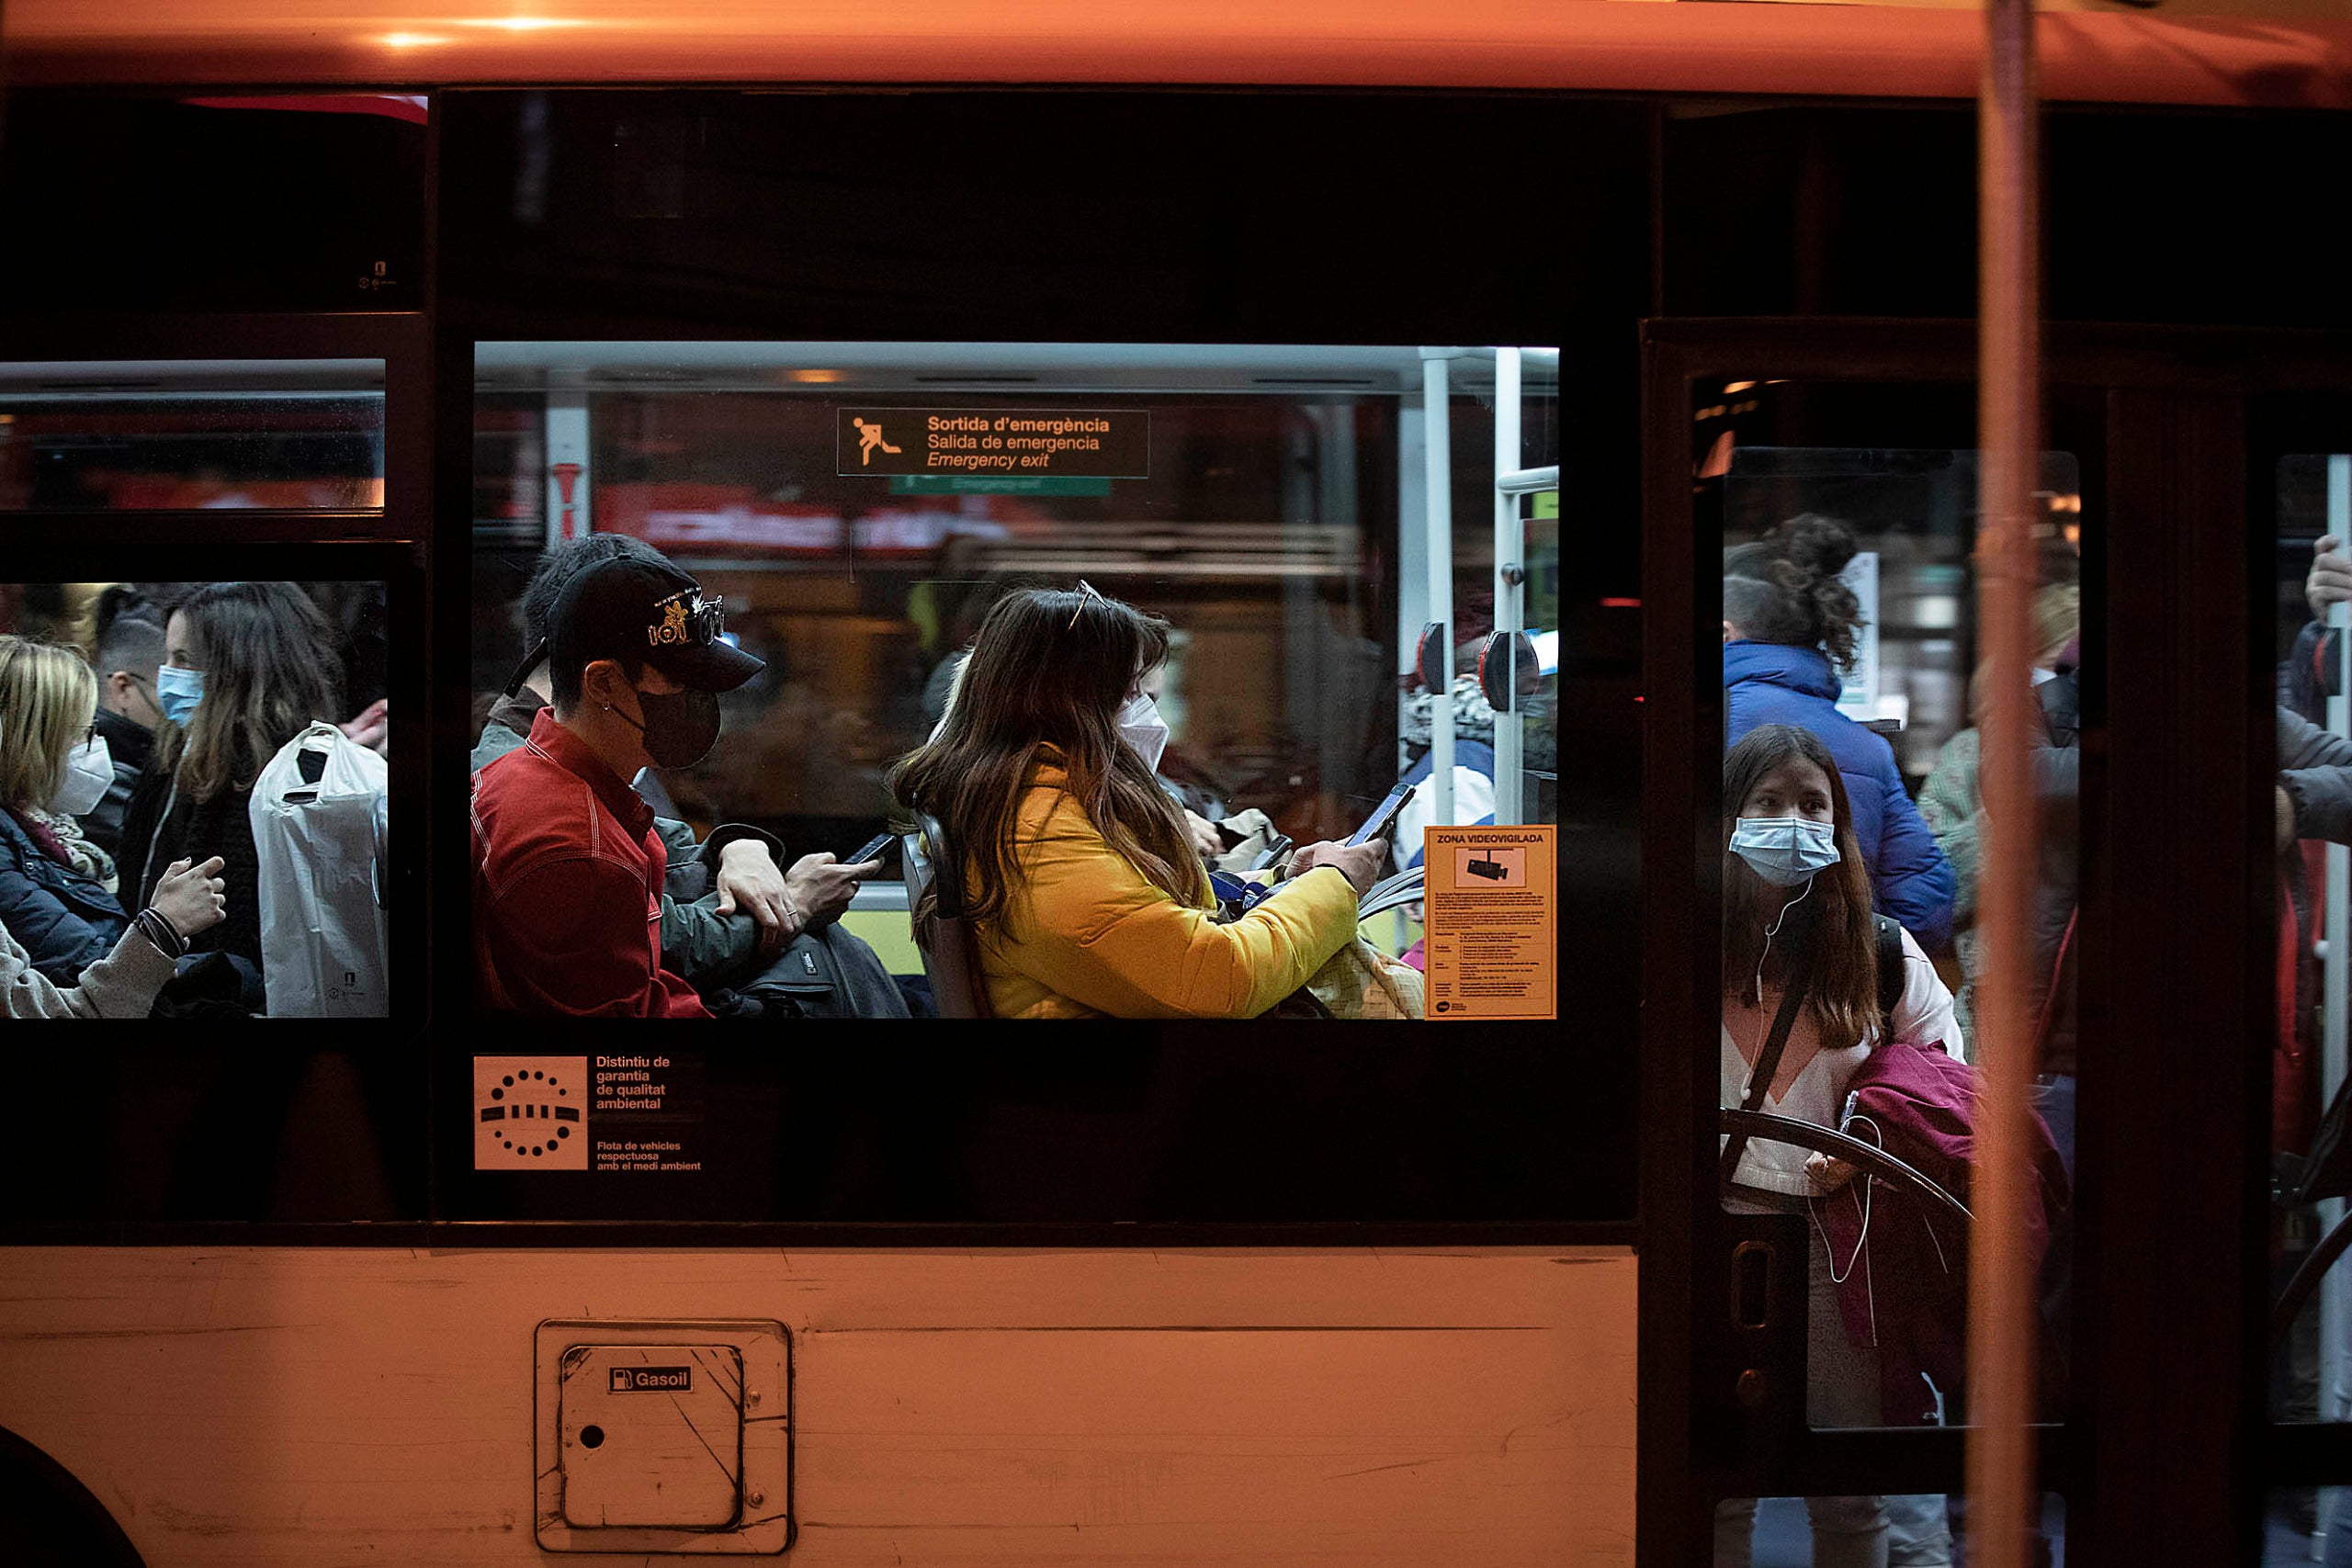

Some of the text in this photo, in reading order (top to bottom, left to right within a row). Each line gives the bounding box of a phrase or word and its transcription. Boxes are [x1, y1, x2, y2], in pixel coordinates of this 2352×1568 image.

[927, 416, 1110, 434] Sortida d'emergència
[927, 434, 1100, 452] Salida de emergencia
[927, 453, 1050, 470] Emergency exit
[1437, 834, 1544, 843] ZONA VIDEOVIGILADA
[596, 1055, 670, 1067] Distintiu de
[596, 1069, 650, 1083] garantia
[596, 1083, 666, 1098] de qualitat
[596, 1097, 662, 1110] ambiental
[596, 1141, 681, 1151] Flota de vehicles
[596, 1152, 660, 1163] respectuosa
[596, 1161, 701, 1170] amb el medi ambient
[636, 1371, 687, 1386] Gasoil
